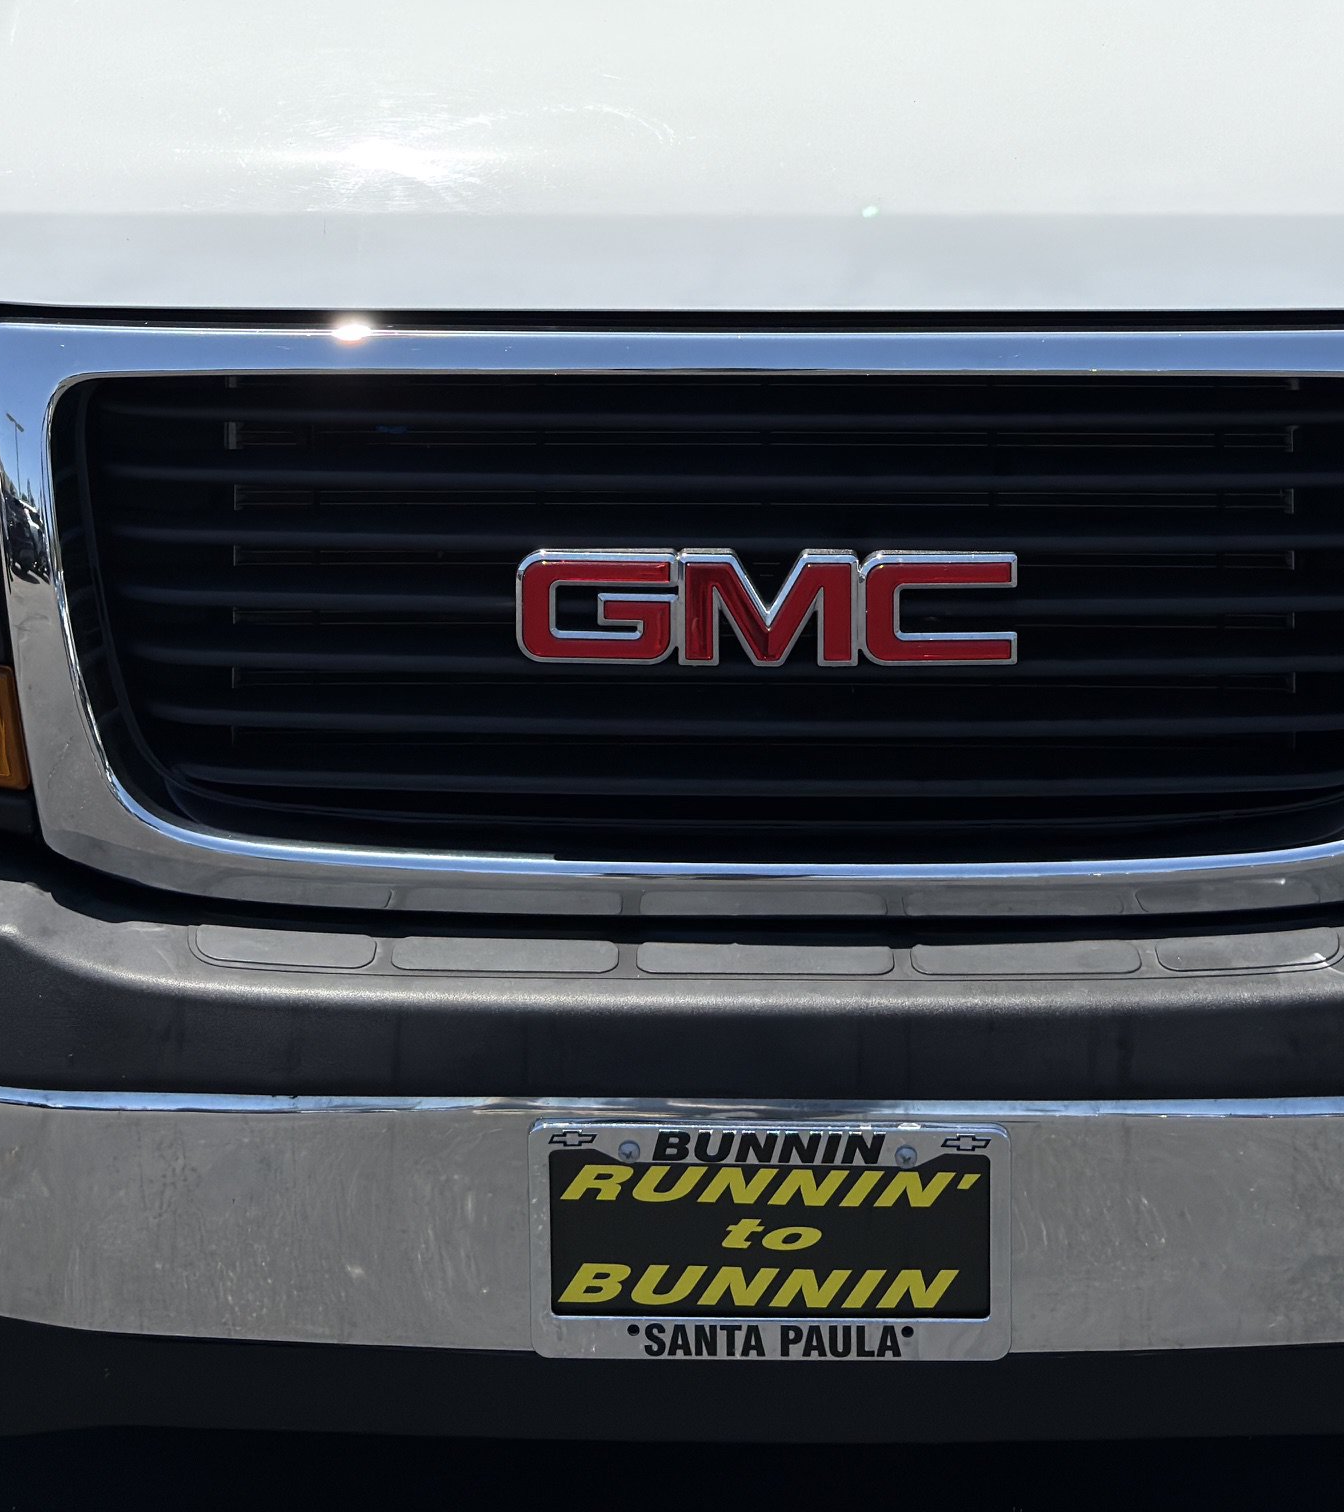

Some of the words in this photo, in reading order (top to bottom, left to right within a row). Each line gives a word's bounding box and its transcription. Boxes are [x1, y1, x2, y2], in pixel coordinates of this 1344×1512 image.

[516, 548, 1017, 666] GMC
[651, 1131, 886, 1164] BUNNIN
[560, 1164, 982, 1207] RUNNIN'
[721, 1218, 823, 1251] to
[557, 1262, 960, 1309] BUNNIN
[644, 1323, 766, 1357] SANTA
[780, 1323, 902, 1357] PAULA
